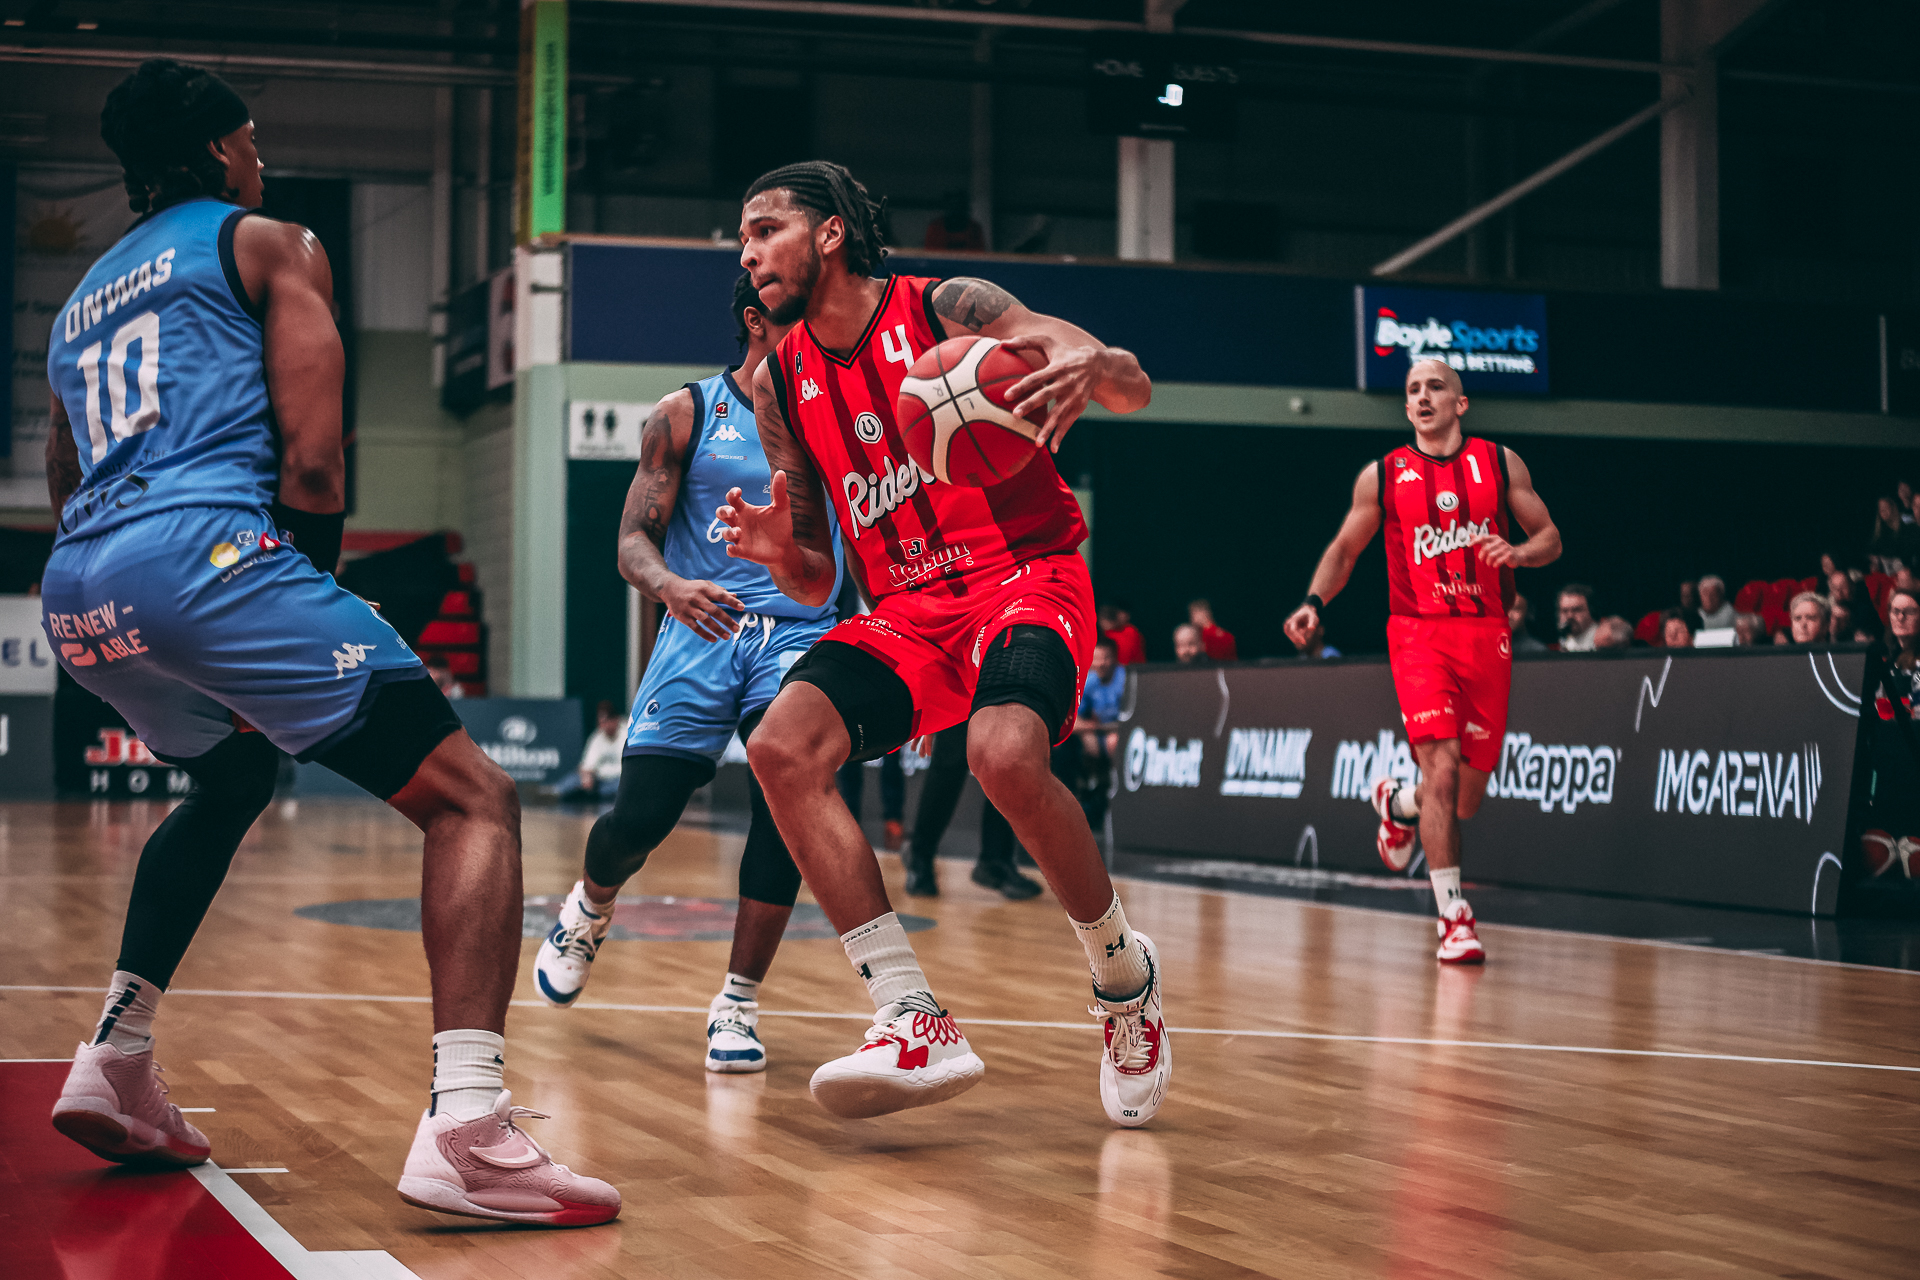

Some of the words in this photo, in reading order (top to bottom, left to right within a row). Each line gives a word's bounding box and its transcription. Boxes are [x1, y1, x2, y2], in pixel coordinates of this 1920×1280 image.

[1092, 58, 1144, 78] HOME
[880, 324, 915, 371] 4
[1375, 315, 1539, 354] BoyleSports
[77, 311, 160, 466] 10
[1467, 454, 1483, 484] 1
[842, 453, 935, 540] Rider
[49, 600, 118, 640] RENEW
[98, 628, 150, 663] ABLE
[89, 769, 191, 794] HOM
[1331, 729, 1421, 802] molte
[1499, 732, 1617, 814] Kappa
